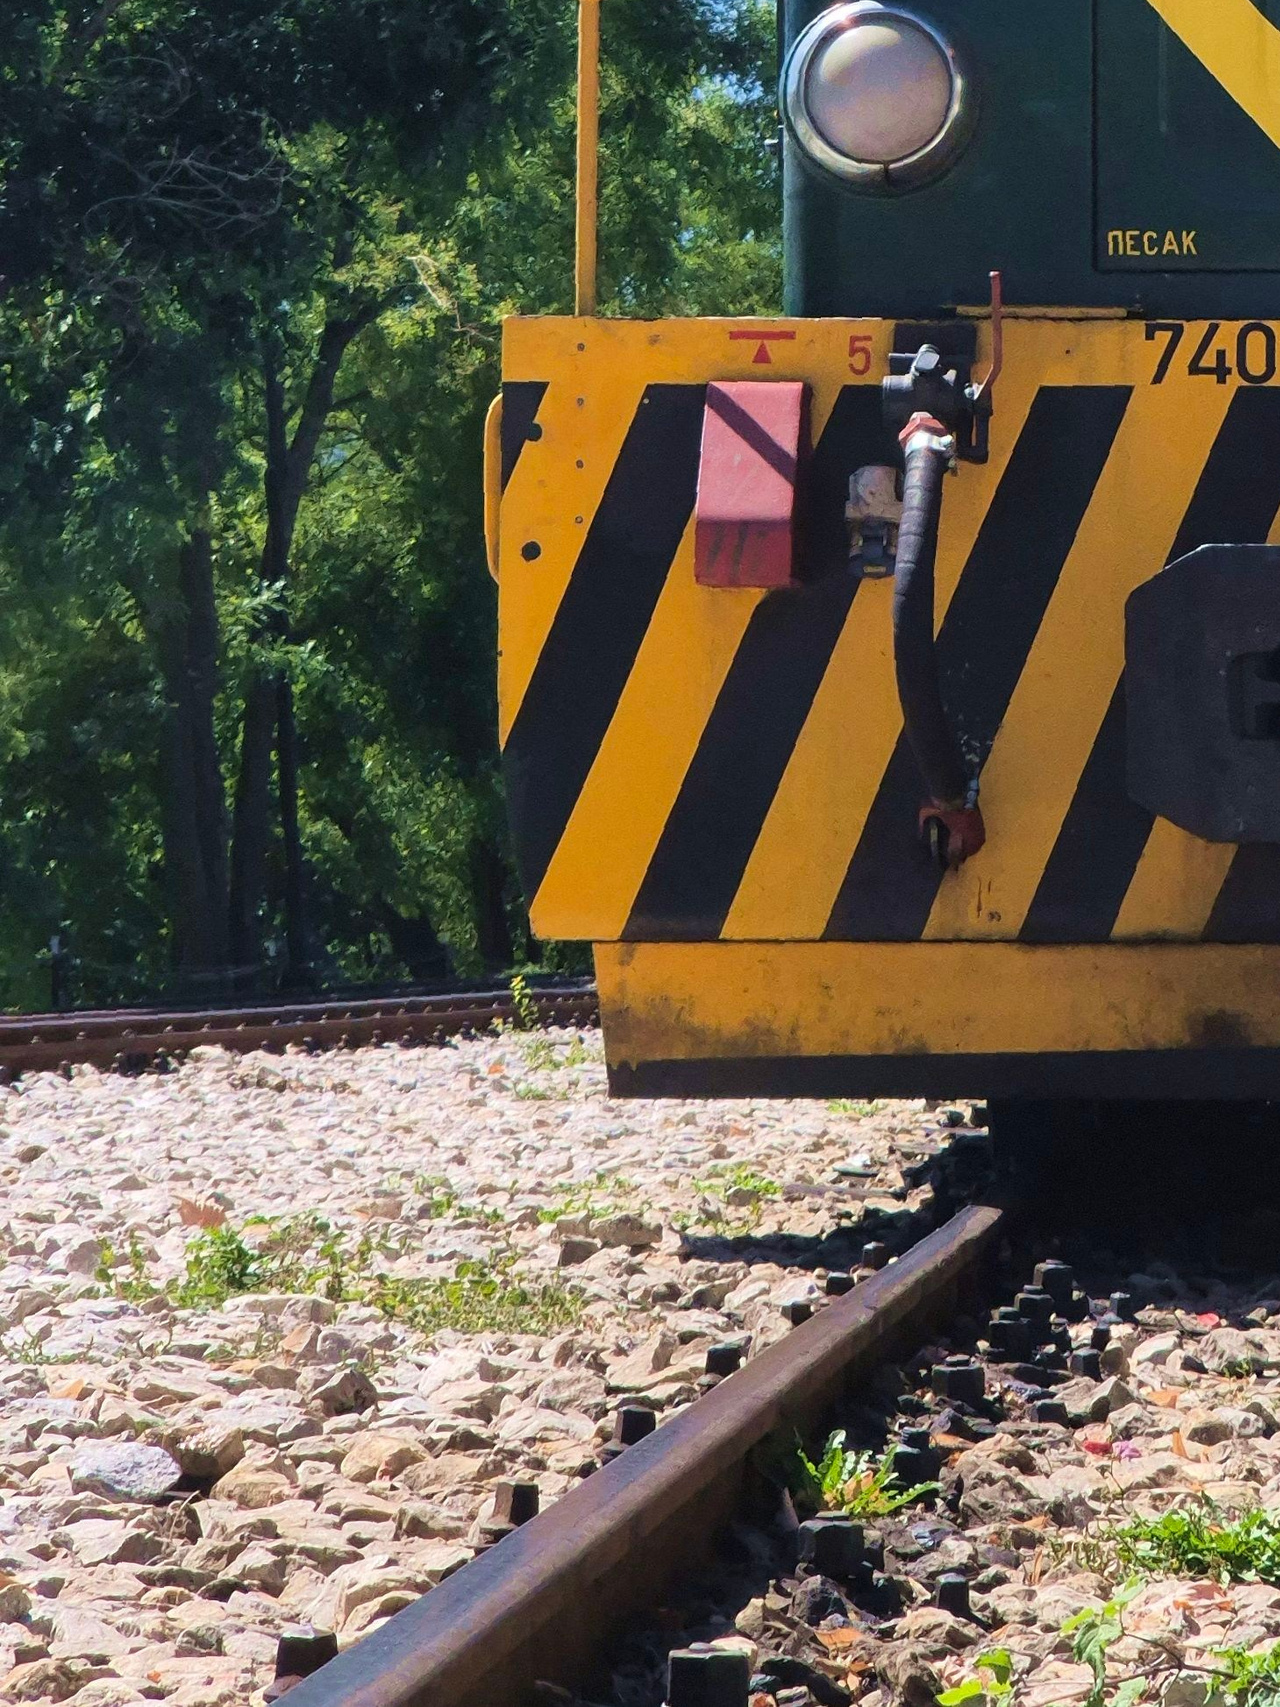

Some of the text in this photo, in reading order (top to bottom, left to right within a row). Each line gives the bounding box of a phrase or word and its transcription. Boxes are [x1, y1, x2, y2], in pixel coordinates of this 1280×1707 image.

[1107, 230, 1198, 256] ПЕСАК
[848, 334, 873, 376] 5
[1144, 322, 1277, 385] 740
